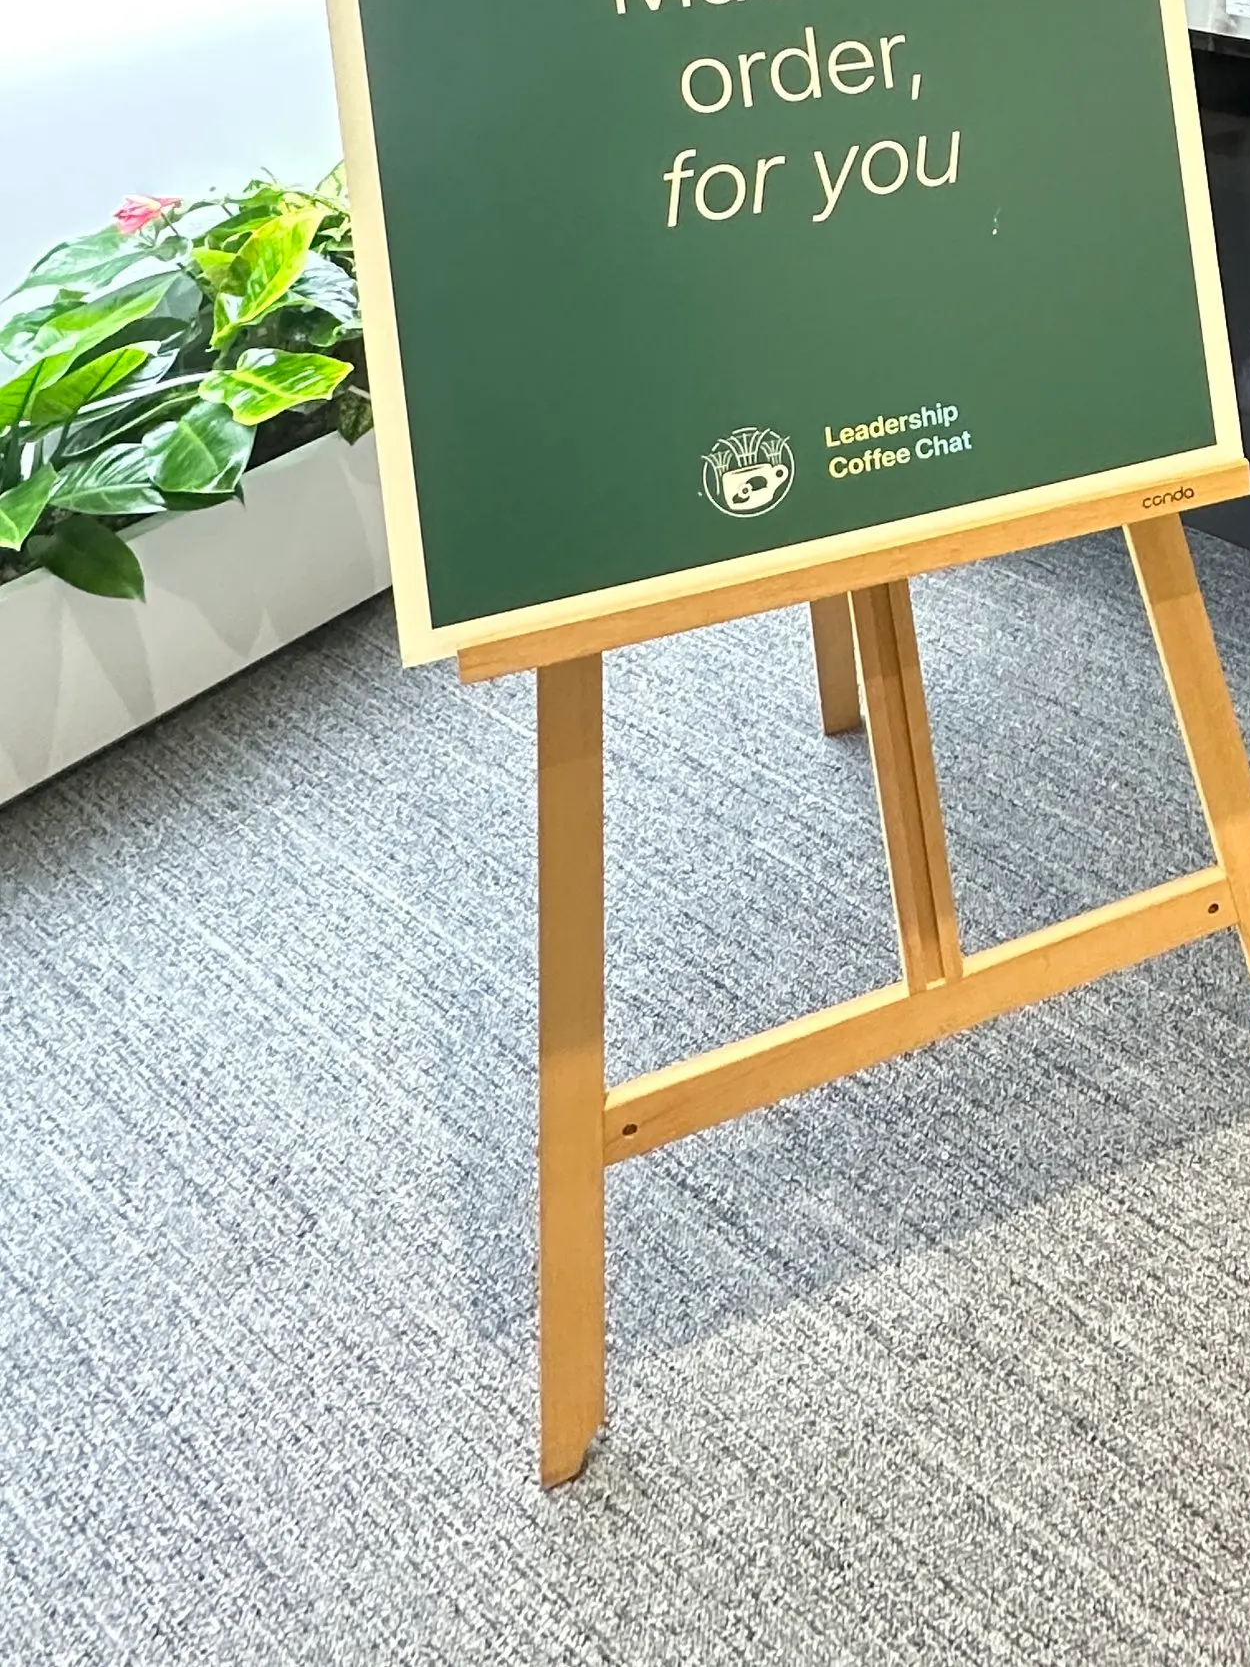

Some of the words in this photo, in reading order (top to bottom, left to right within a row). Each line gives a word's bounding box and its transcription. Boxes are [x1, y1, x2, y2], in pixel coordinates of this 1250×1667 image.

[681, 26, 922, 114] order,
[662, 148, 786, 228] for
[811, 130, 961, 223] you
[824, 402, 959, 448] Leadership
[828, 446, 911, 479] Coffee
[914, 430, 973, 460] Chat
